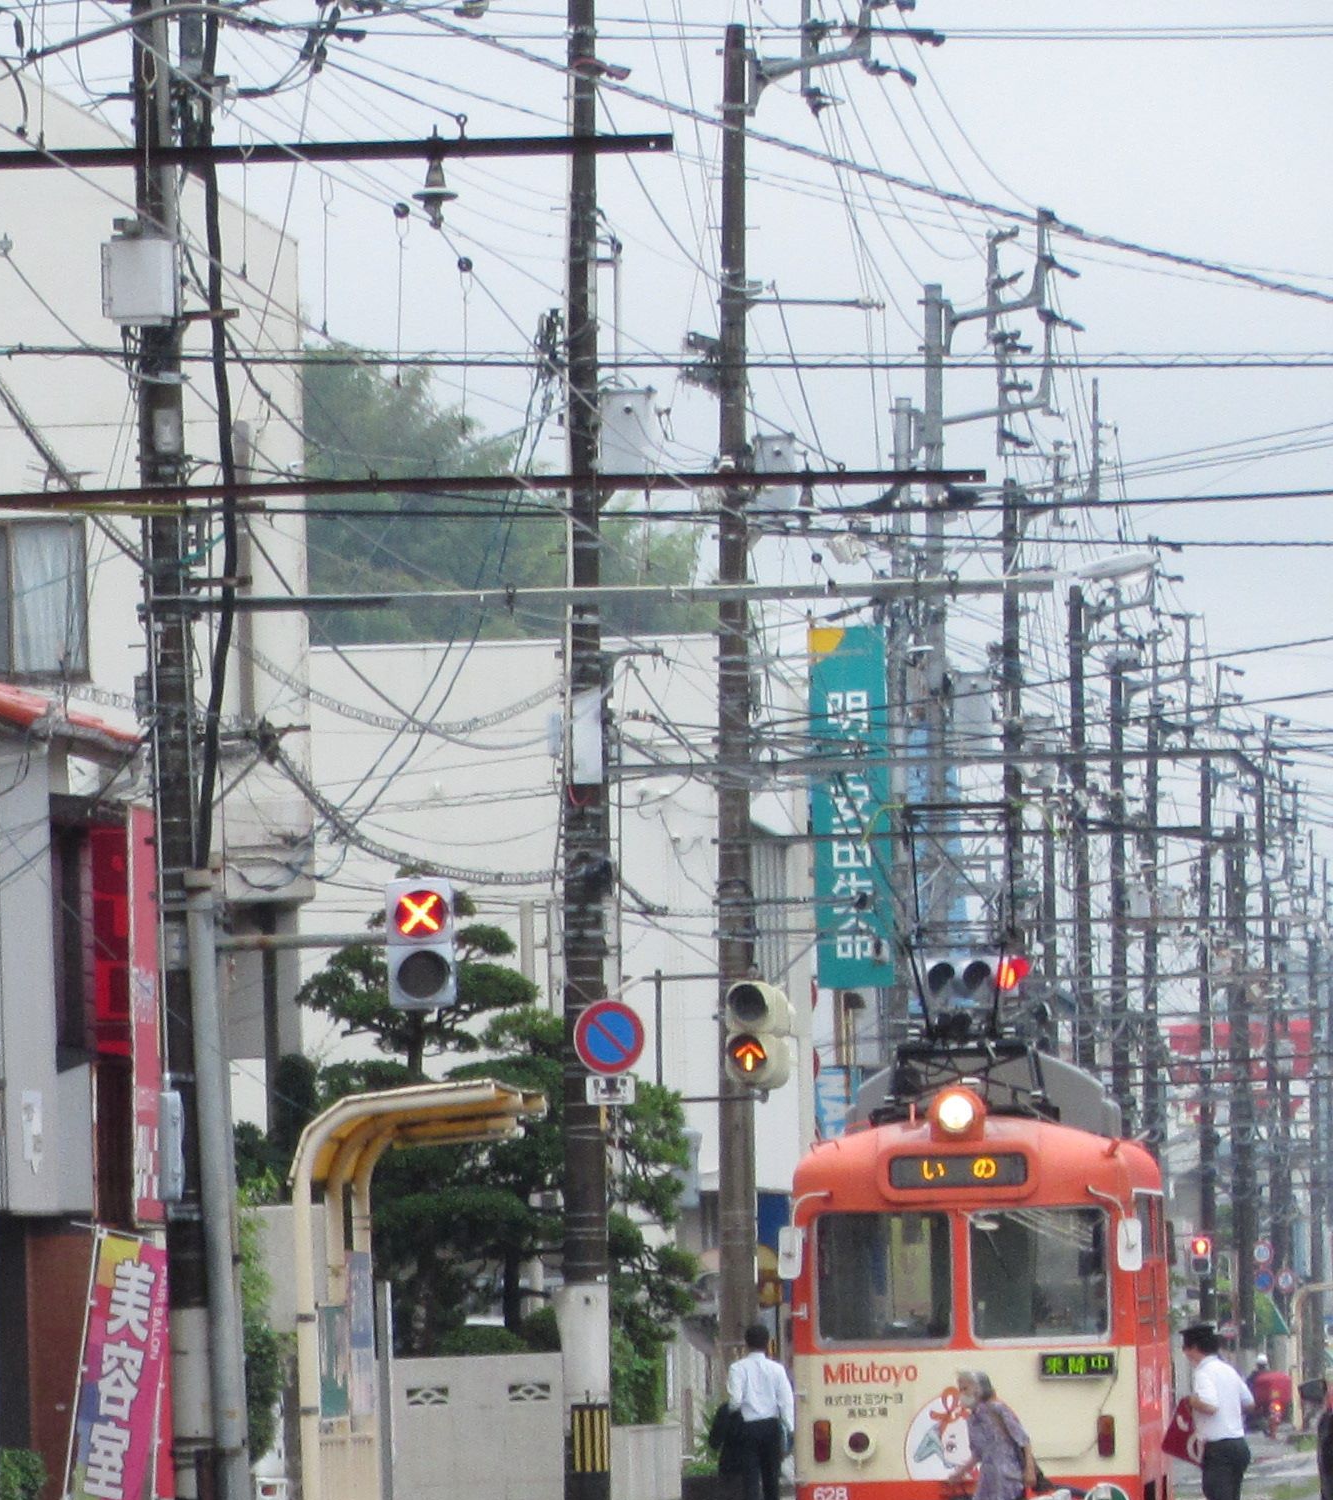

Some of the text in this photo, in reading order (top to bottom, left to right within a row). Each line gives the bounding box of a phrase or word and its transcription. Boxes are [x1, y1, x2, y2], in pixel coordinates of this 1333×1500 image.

[83, 1259, 156, 1500] 美容室
[823, 1361, 917, 1386] Mitutoyo
